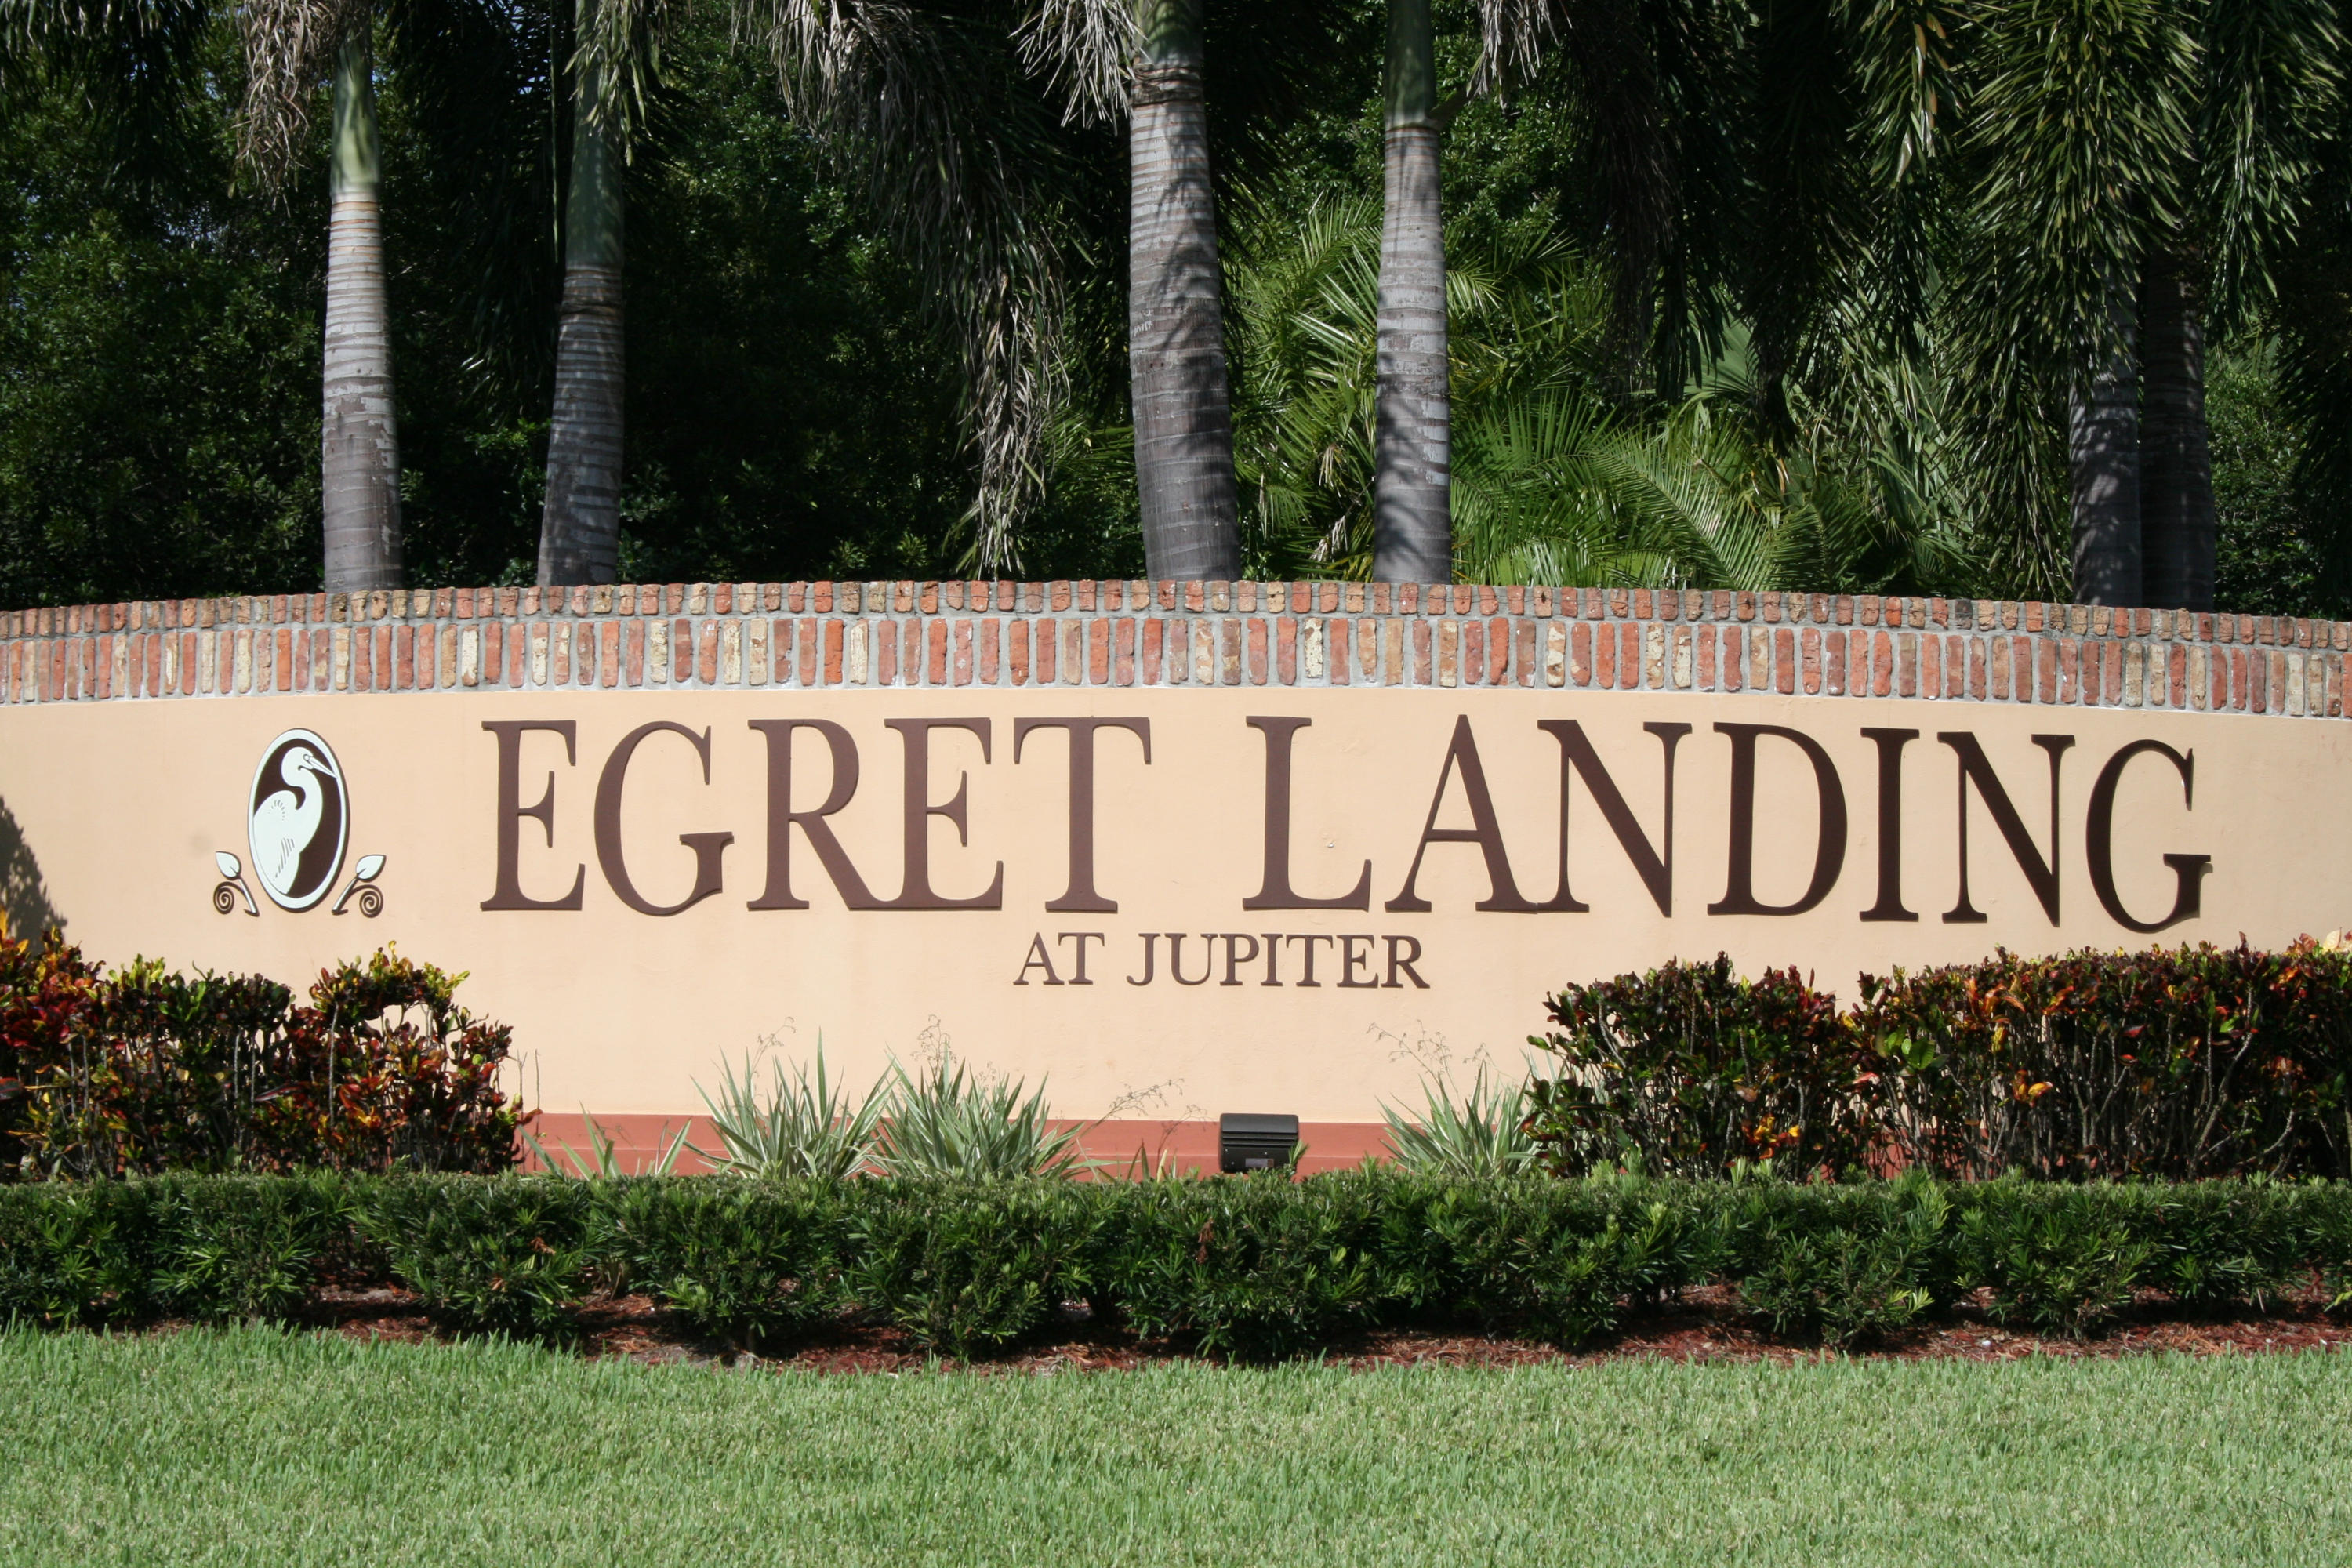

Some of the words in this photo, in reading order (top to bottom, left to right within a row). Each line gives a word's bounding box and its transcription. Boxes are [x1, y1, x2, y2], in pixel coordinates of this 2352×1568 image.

[480, 718, 1152, 916] EGRET
[1242, 713, 2213, 935] LANDING
[1013, 931, 1105, 986] AT
[1126, 932, 1431, 989] JUPITER
